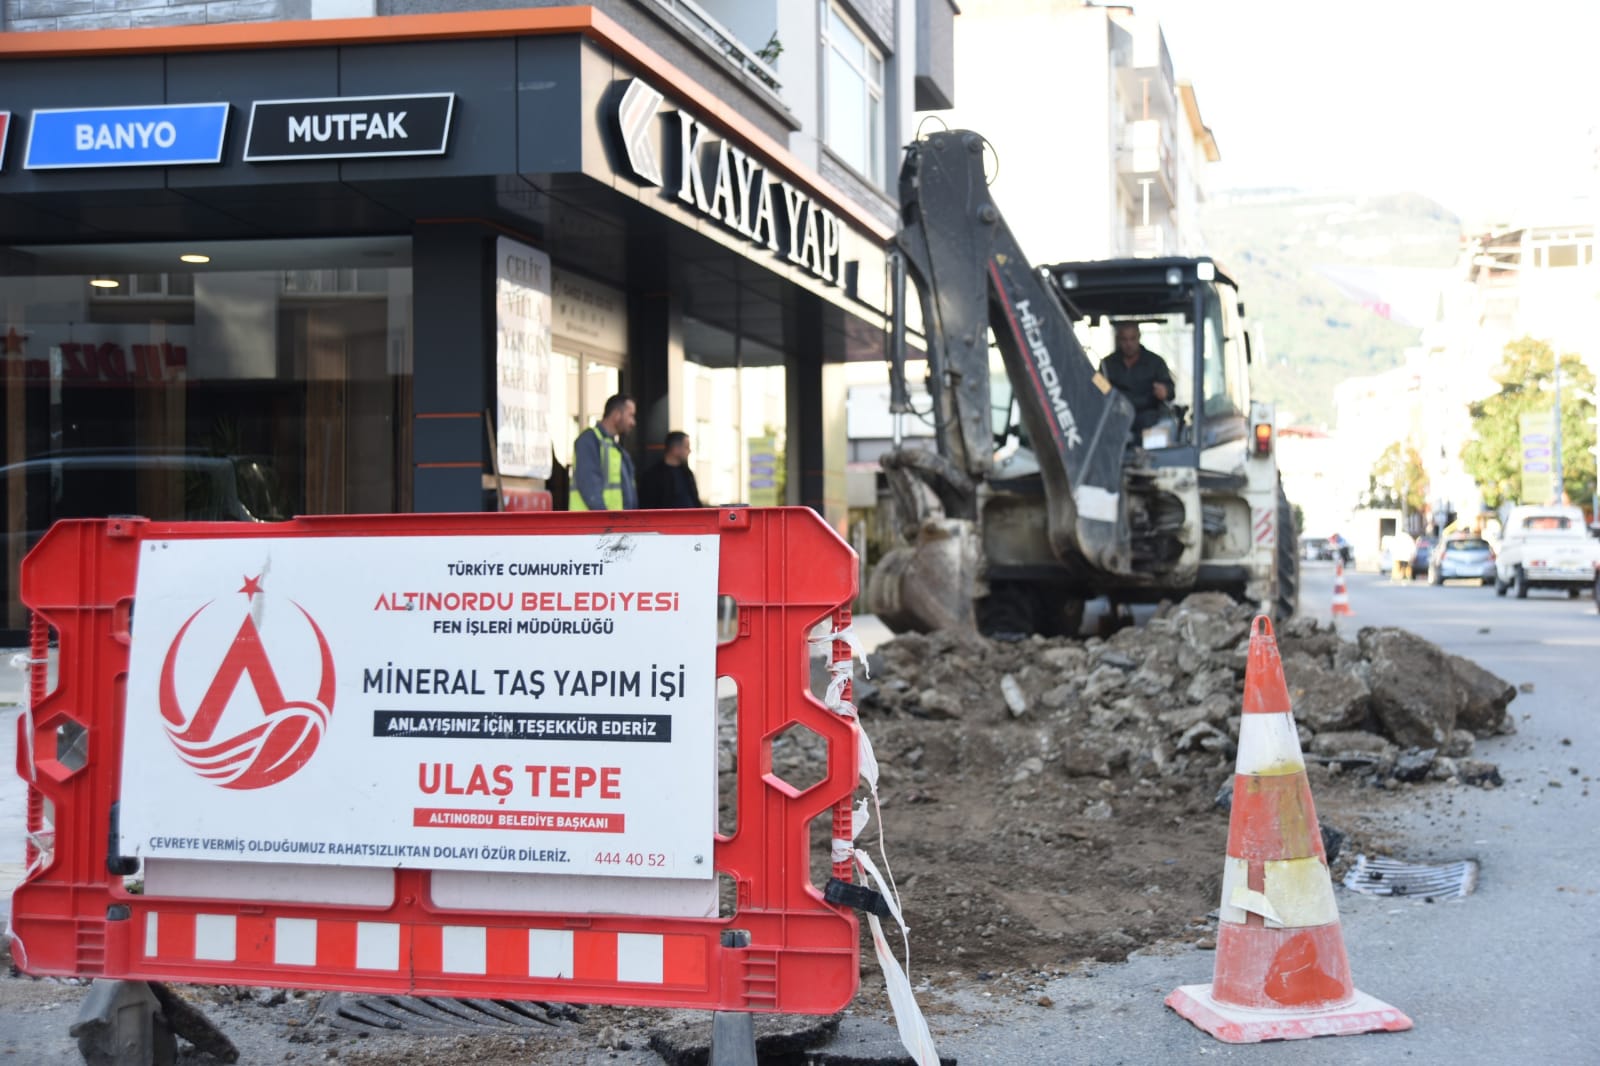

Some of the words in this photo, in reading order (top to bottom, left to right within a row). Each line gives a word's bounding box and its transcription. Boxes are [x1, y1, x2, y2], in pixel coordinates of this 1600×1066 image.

[75, 121, 177, 151] BANYO
[287, 111, 408, 143] MUTFAK
[677, 109, 780, 251] KAYA
[448, 561, 504, 576] TÜRKİYE
[508, 560, 604, 577] CUMHURİYETİ
[373, 592, 514, 611] ALTINORDU
[520, 591, 680, 612] BELEDİYESİ
[433, 620, 462, 634] FEN
[466, 617, 513, 636] İŞLERİ
[517, 617, 614, 635] MÜDÜRLÜĞÜ
[363, 662, 486, 695] MİNERAL
[494, 669, 545, 700] TAŞ
[553, 671, 641, 698] YAPIM
[650, 664, 686, 702] İŞİ
[387, 717, 480, 734] ANLAYIŞINIZ
[483, 715, 514, 735] İÇİN
[517, 717, 598, 736] TEŞEKKÜR
[601, 718, 657, 737] EDERİZ
[418, 763, 514, 804] ULAŞ
[525, 765, 622, 799] TEPE
[429, 813, 493, 825] ALTINORDU
[498, 813, 554, 827] BELEDİYE
[556, 816, 609, 830] BAŞKANI
[149, 837, 200, 850] ÇEVREYE
[202, 837, 245, 852] VERMİŞ
[248, 839, 326, 854] OLDUĞUMUZ
[328, 843, 430, 857] RAHATSIZLIKTAN
[433, 846, 478, 860] DOLAYI
[481, 846, 516, 861] ÖZÜR
[518, 847, 571, 863] DİLERİZ.
[595, 852, 620, 865] 444
[625, 853, 643, 866] 40
[648, 854, 666, 867] 52
